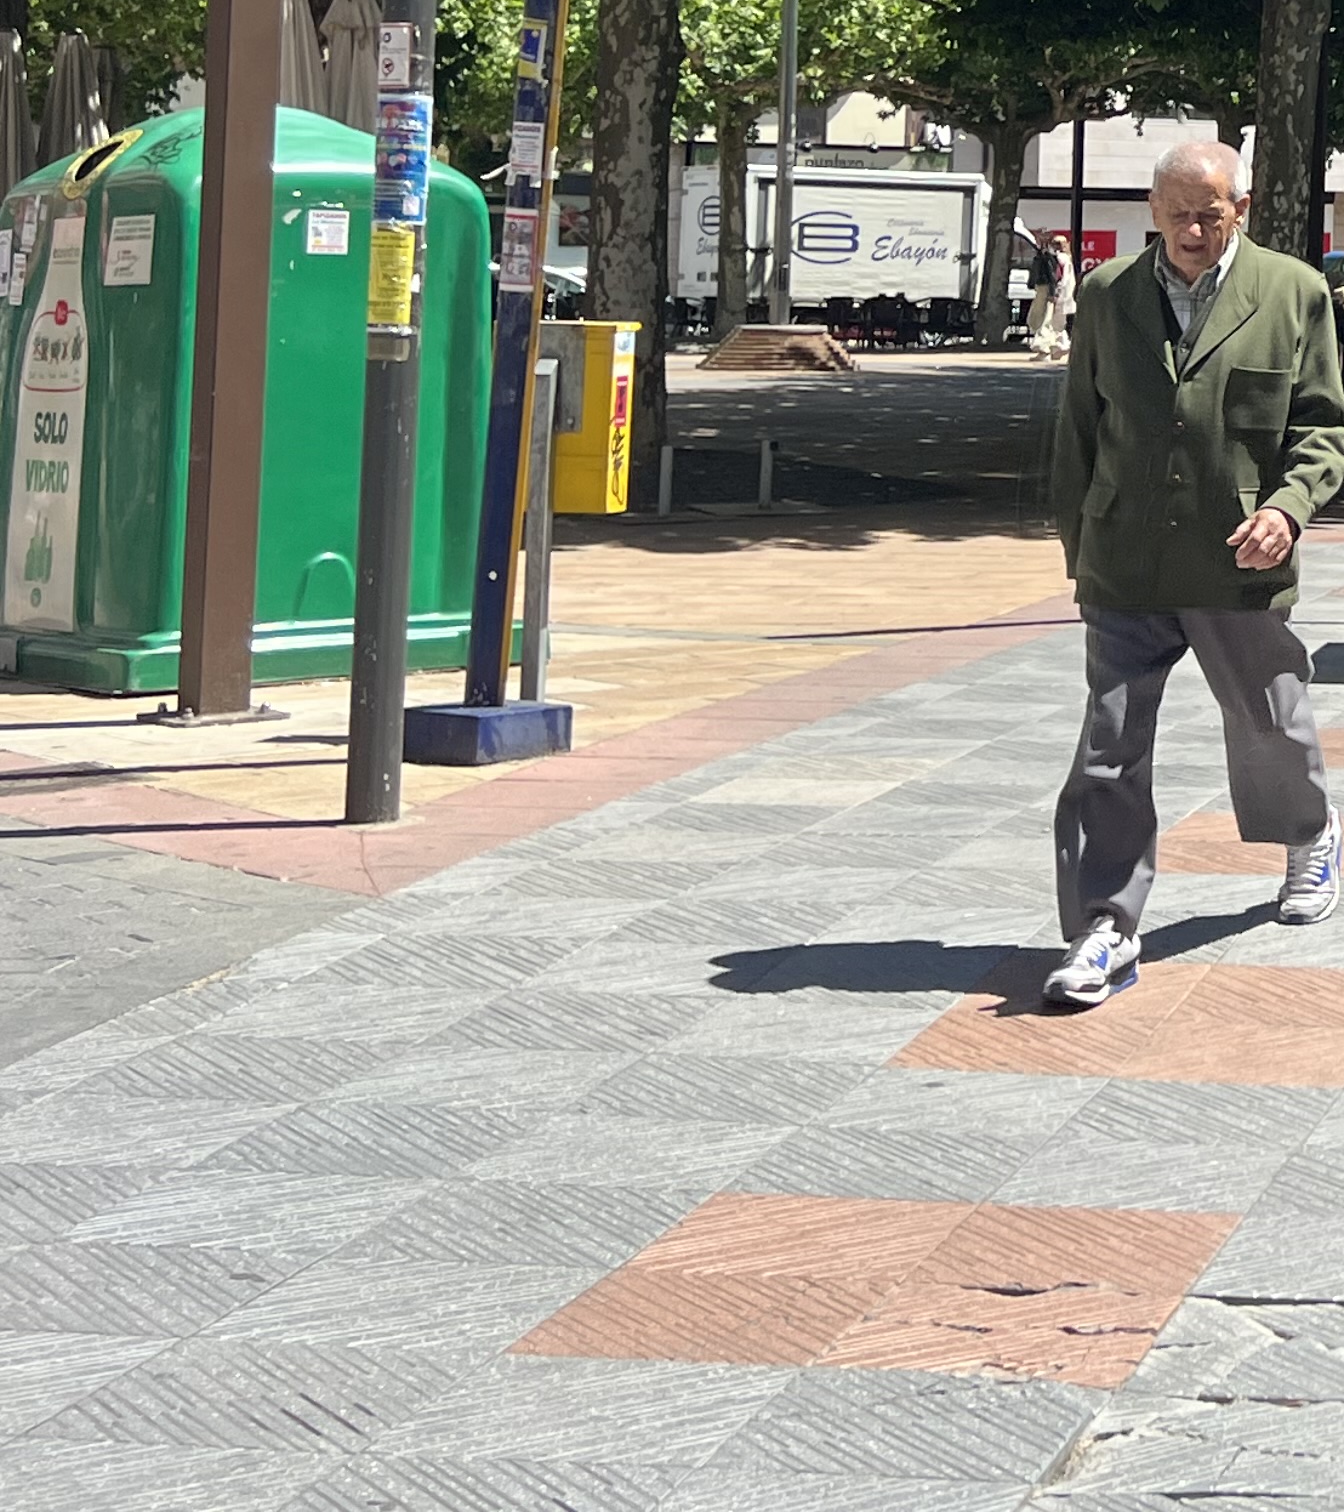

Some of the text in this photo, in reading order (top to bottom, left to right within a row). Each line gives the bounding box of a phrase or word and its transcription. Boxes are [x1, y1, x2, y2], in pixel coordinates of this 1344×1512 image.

[871, 236, 948, 266] Ebayón
[34, 412, 68, 445] SOLO
[26, 459, 69, 493] VIDRIO
